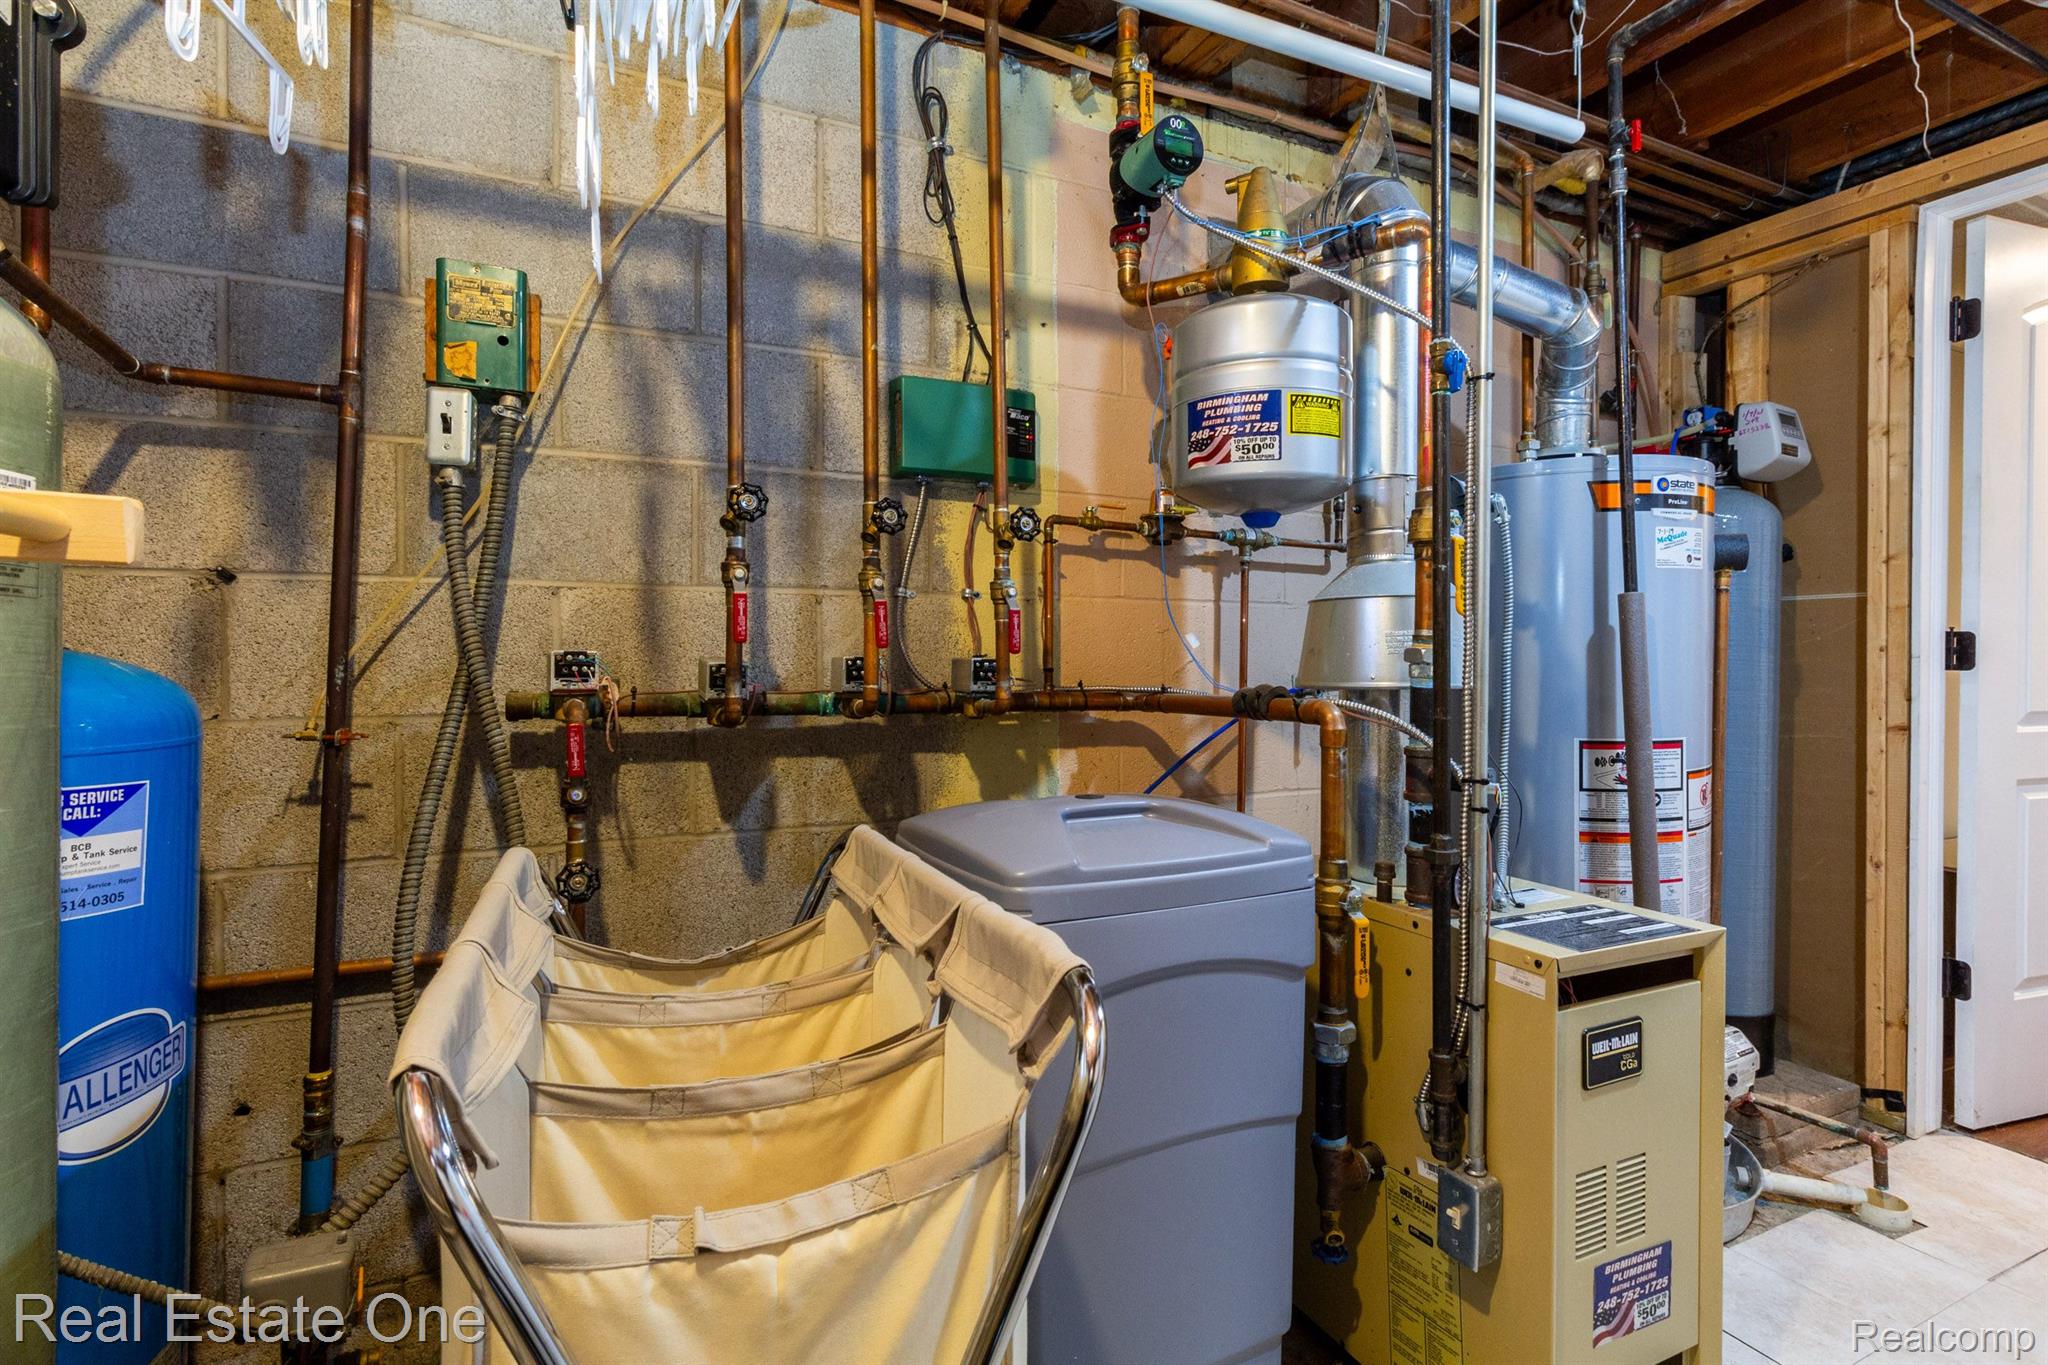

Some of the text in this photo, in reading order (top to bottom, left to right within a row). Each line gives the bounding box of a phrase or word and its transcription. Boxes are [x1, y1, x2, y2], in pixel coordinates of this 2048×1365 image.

[1197, 393, 1269, 411] BIRMINGHAM
[1204, 403, 1262, 418] PLUMBING
[1202, 417, 1226, 428] HEATING
[1232, 413, 1261, 423] COOLING
[1190, 421, 1279, 442] 248-752-1725
[1234, 437, 1246, 445] 10%
[1247, 436, 1259, 444] OFF
[1670, 479, 1695, 489] state
[69, 788, 125, 806] SERVICE
[63, 807, 102, 821] CALL:
[70, 842, 92, 852] BCB
[71, 853, 79, 861] &
[84, 850, 105, 860] Tank
[108, 844, 138, 856] Service
[61, 859, 102, 871] xpert Service
[87, 882, 112, 891] Service
[118, 877, 137, 887] Repair
[1620, 1058, 1638, 1071] CGa
[62, 1034, 181, 1121] ALLENGER
[1604, 1246, 1663, 1275] BIRMINGHAM
[1612, 1259, 1658, 1284] PLUMBING
[1609, 1281, 1631, 1294] HEATING
[1636, 1270, 1657, 1284] COOLING
[1597, 1276, 1669, 1314] 248-752-1725
